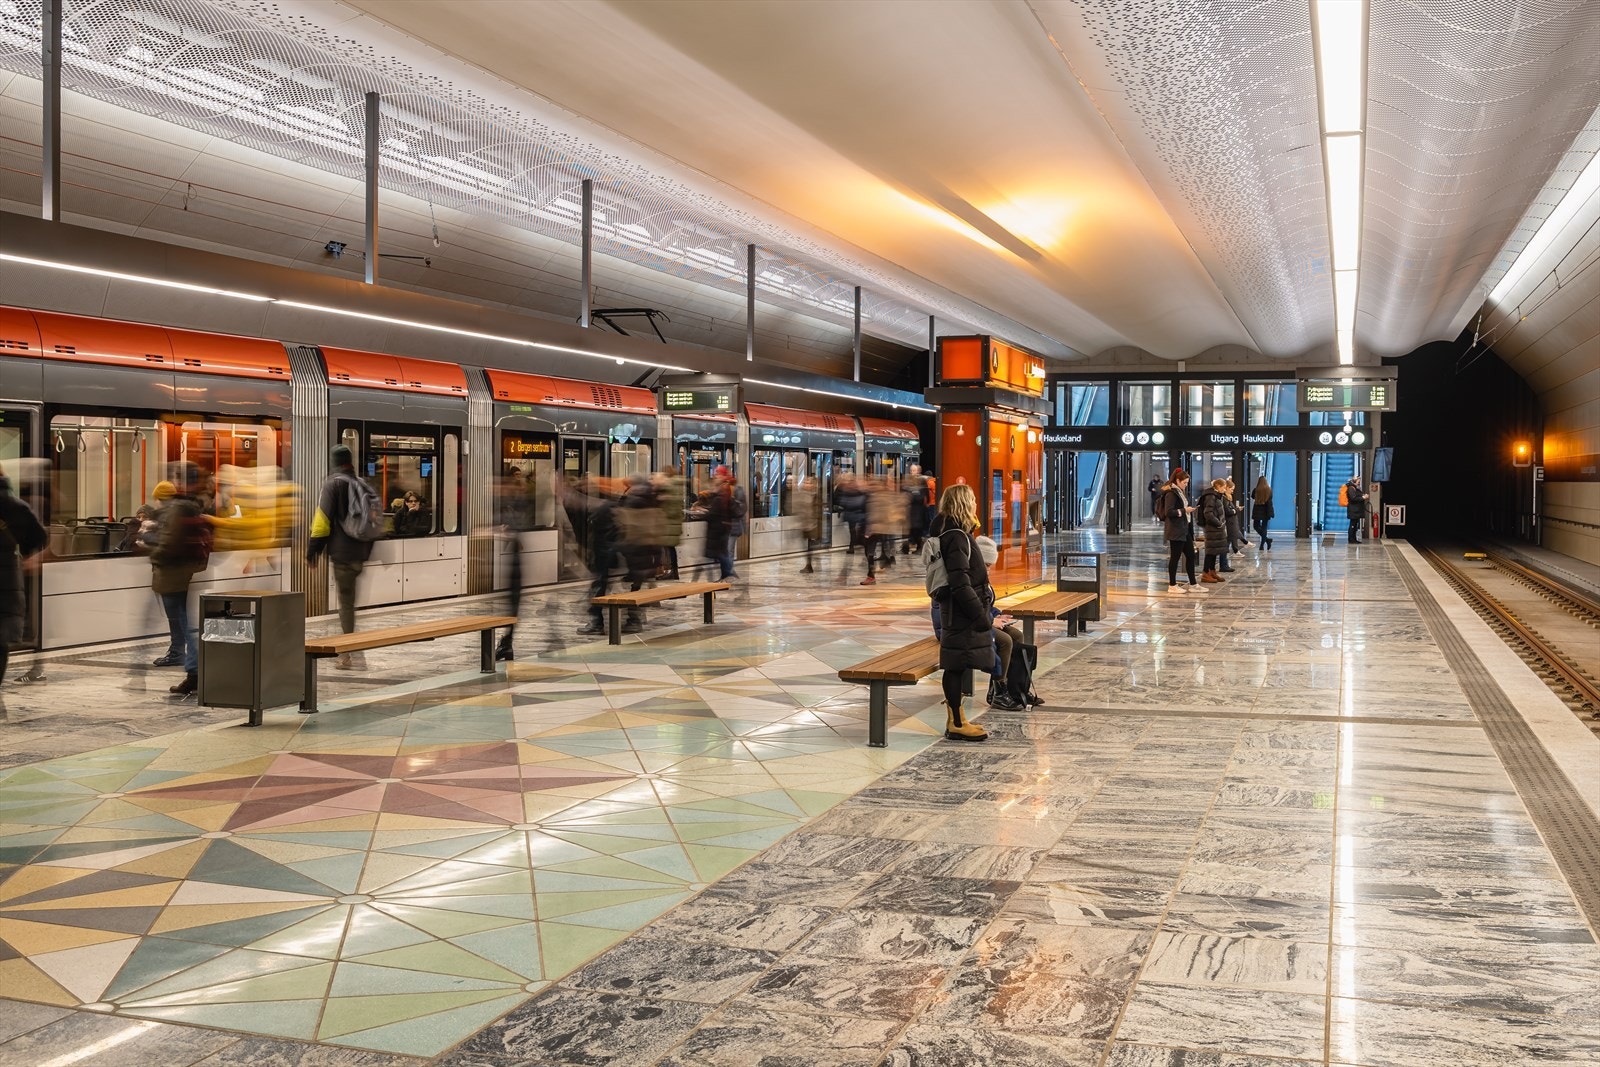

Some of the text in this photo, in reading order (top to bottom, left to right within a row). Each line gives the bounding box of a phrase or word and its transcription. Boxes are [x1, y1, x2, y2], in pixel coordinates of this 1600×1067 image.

[1043, 434, 1082, 442] Haukeland
[1210, 434, 1284, 444] Utgang Haukeland
[510, 440, 550, 455] 2 Bergen sentrum
